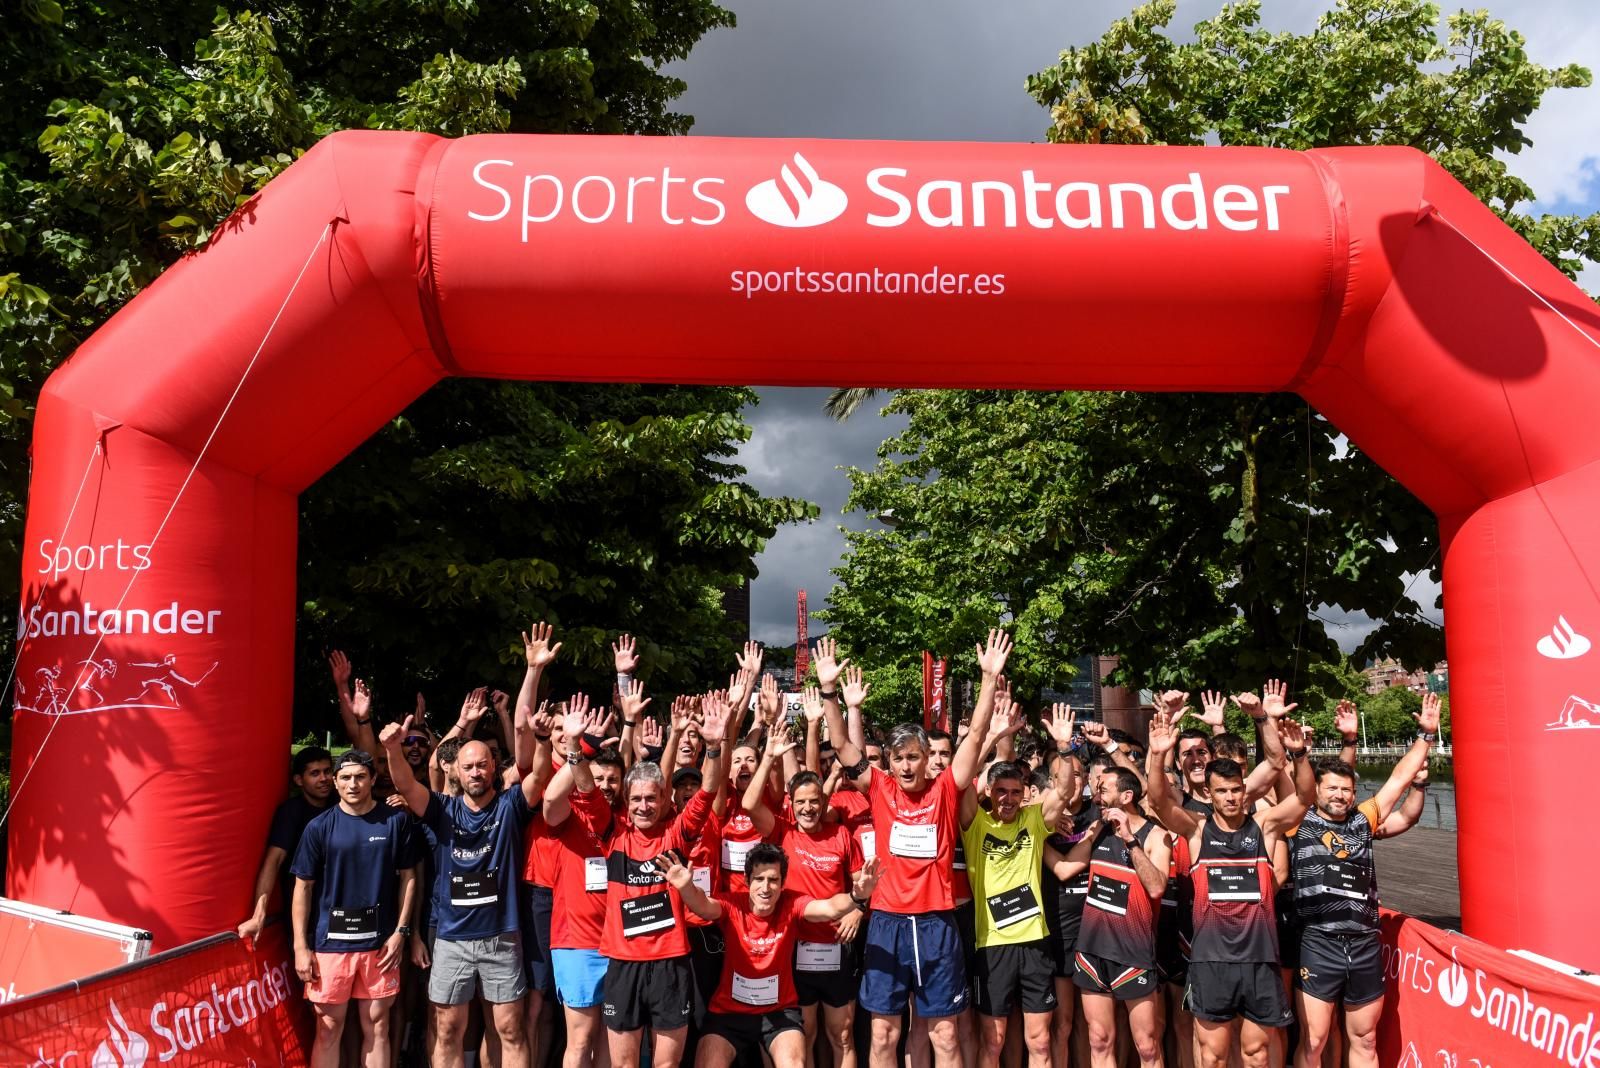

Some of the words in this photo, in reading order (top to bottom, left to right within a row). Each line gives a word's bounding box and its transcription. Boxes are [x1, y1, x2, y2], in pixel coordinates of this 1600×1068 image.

[467, 159, 726, 243] Sports
[865, 166, 1290, 232] Santander
[730, 265, 1005, 299] sportssantander.es
[38, 538, 152, 581] Sports
[28, 602, 222, 638] Santander
[642, 902, 664, 911] SANTANDER
[150, 960, 293, 1062] Santander
[1381, 943, 1435, 993] ports
[1470, 968, 1600, 1068] Santande
